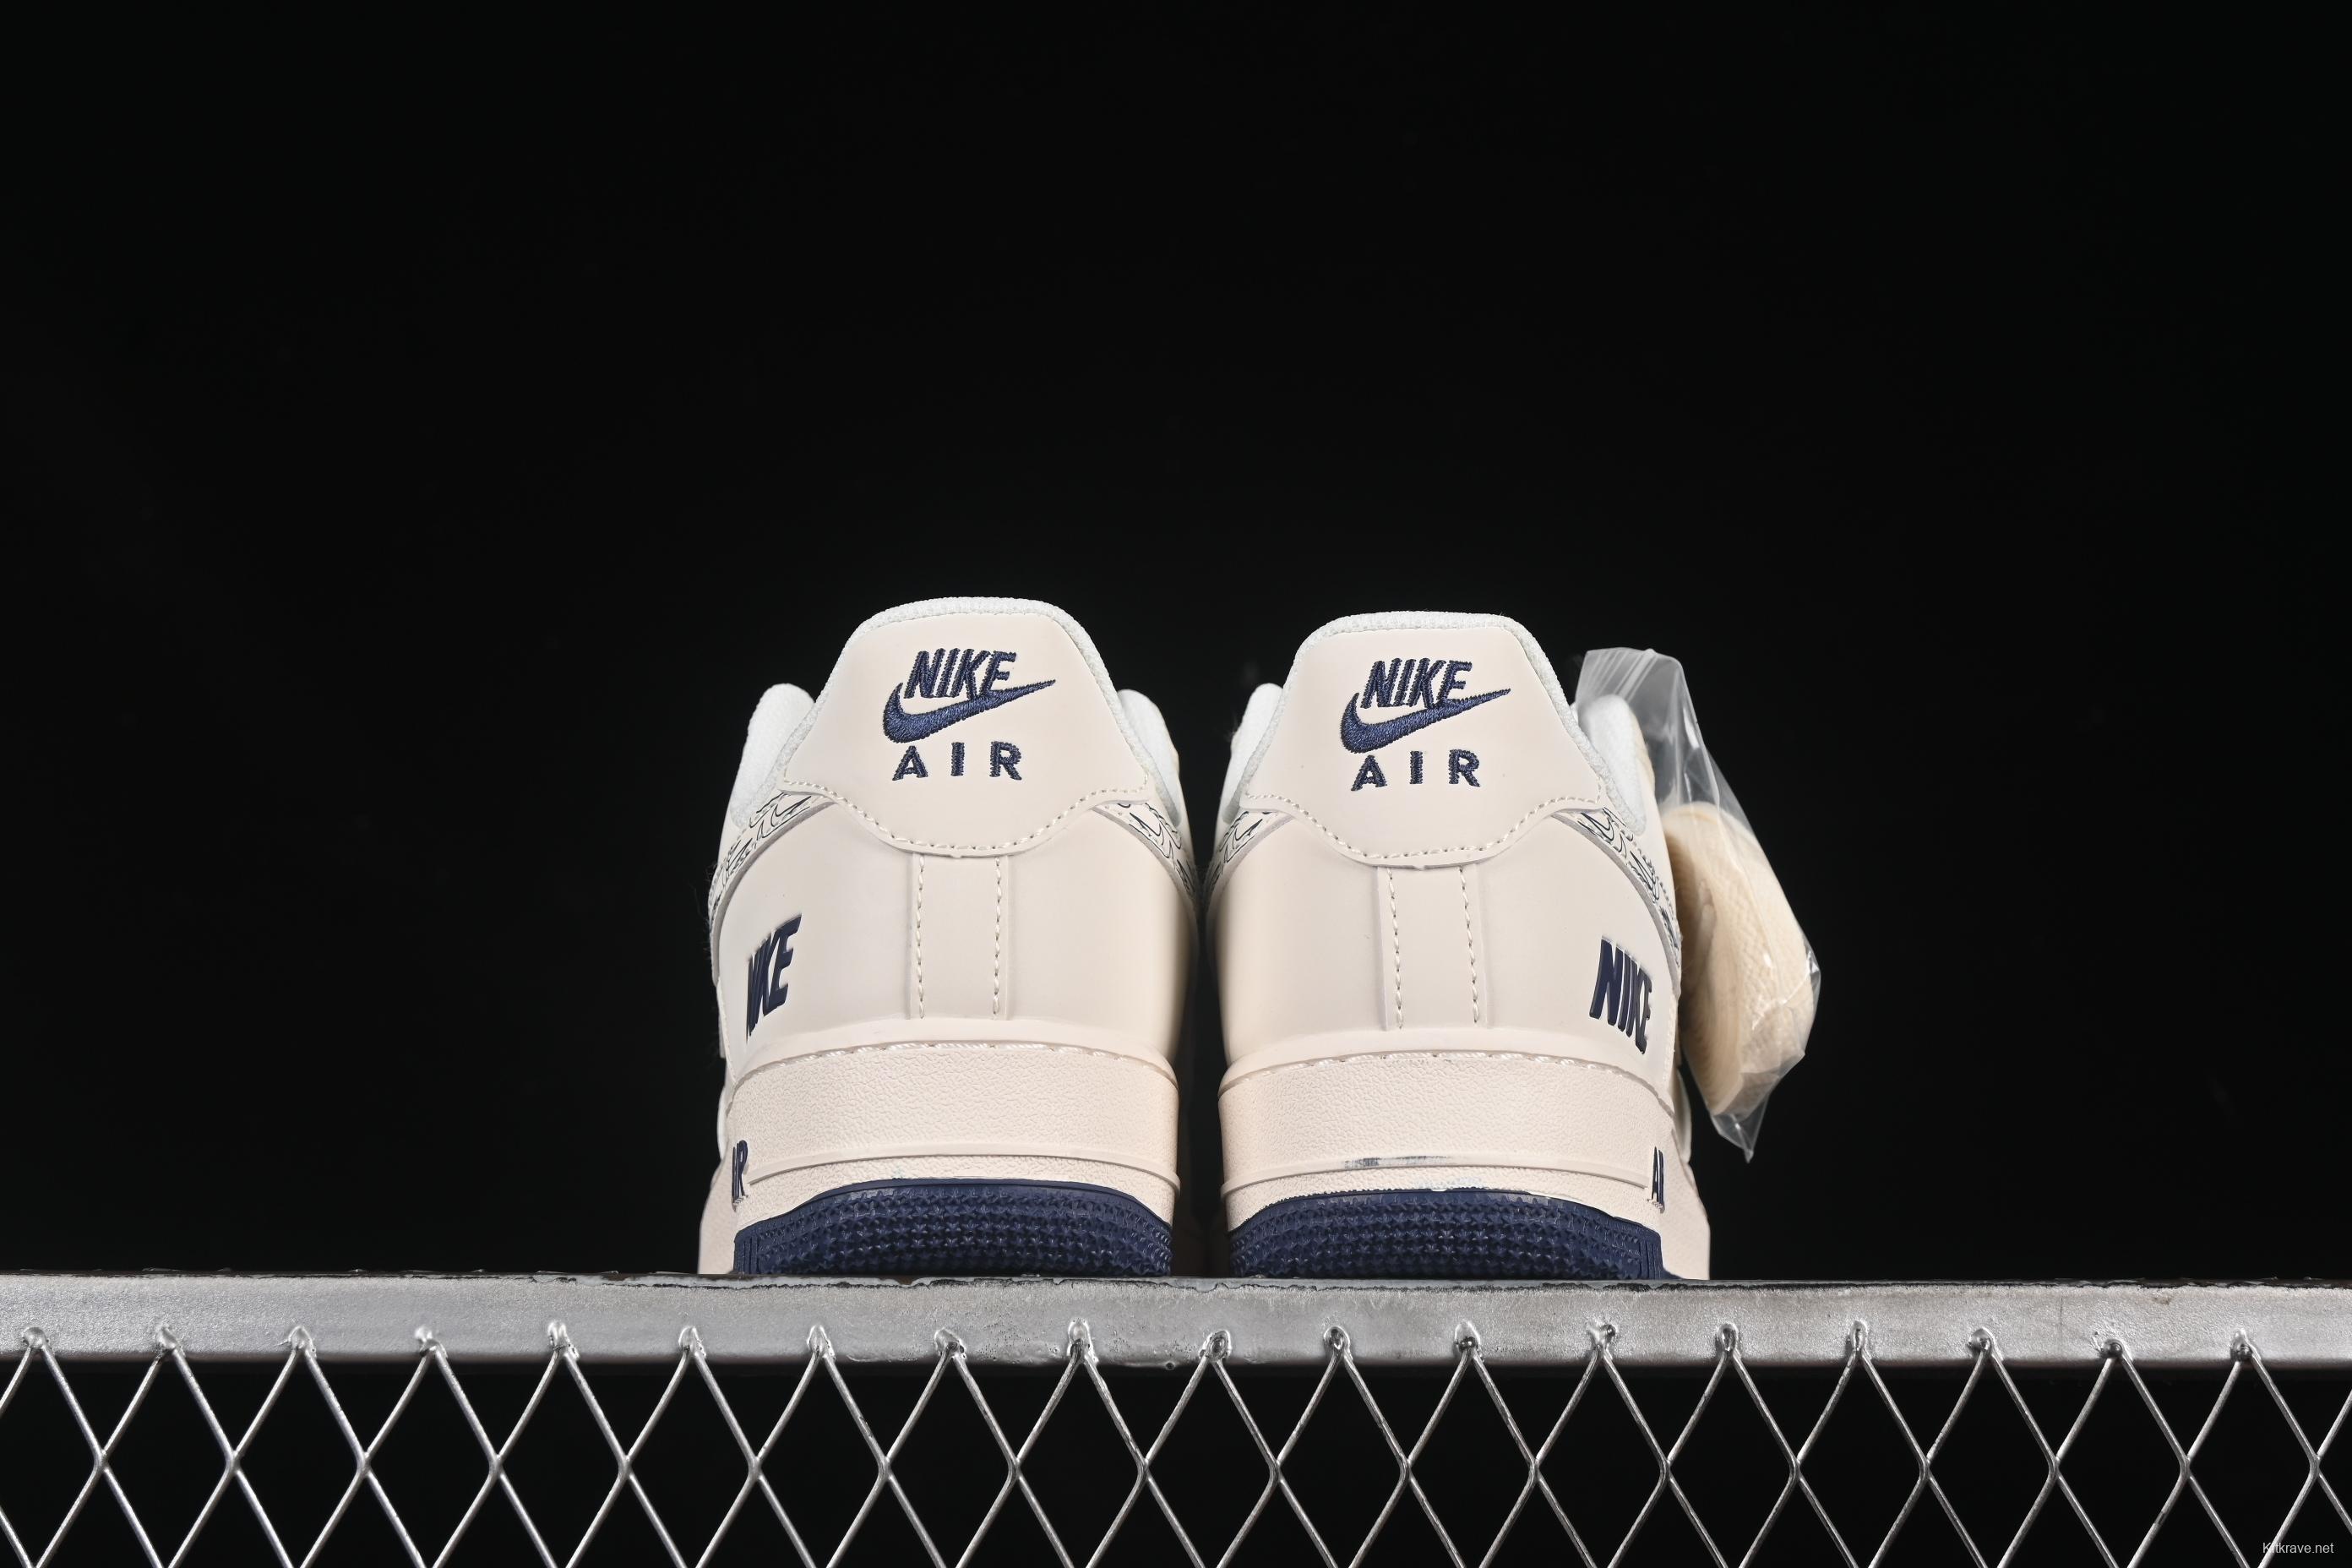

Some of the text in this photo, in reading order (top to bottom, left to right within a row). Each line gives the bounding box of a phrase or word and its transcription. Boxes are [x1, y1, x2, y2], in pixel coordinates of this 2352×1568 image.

[903, 648, 1017, 700] NIKE
[1359, 658, 1473, 710] NIKE
[892, 741, 1022, 781] AIR
[1351, 749, 1480, 792] AIR
[1588, 937, 1652, 1054] NIKE
